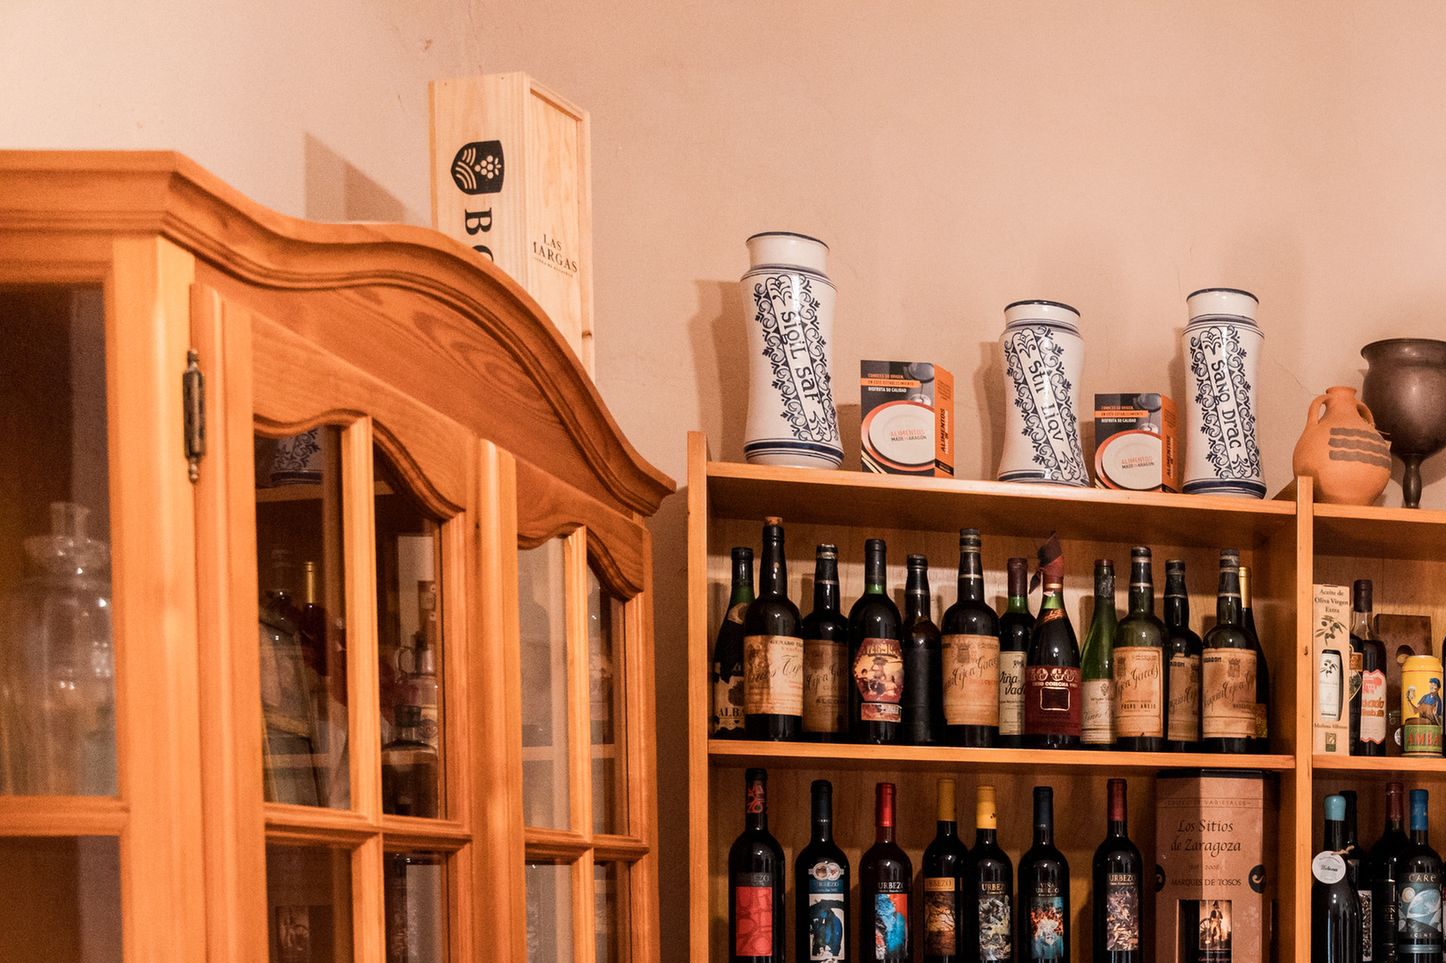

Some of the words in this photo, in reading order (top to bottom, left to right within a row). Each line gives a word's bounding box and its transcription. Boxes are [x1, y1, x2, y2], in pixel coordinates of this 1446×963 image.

[543, 233, 562, 251] LAS
[1330, 598, 1349, 606] Virgen
[1177, 820, 1195, 832] Los
[1198, 819, 1234, 832] Sitios
[1170, 840, 1182, 851] de
[1184, 840, 1241, 857] Zaragoza
